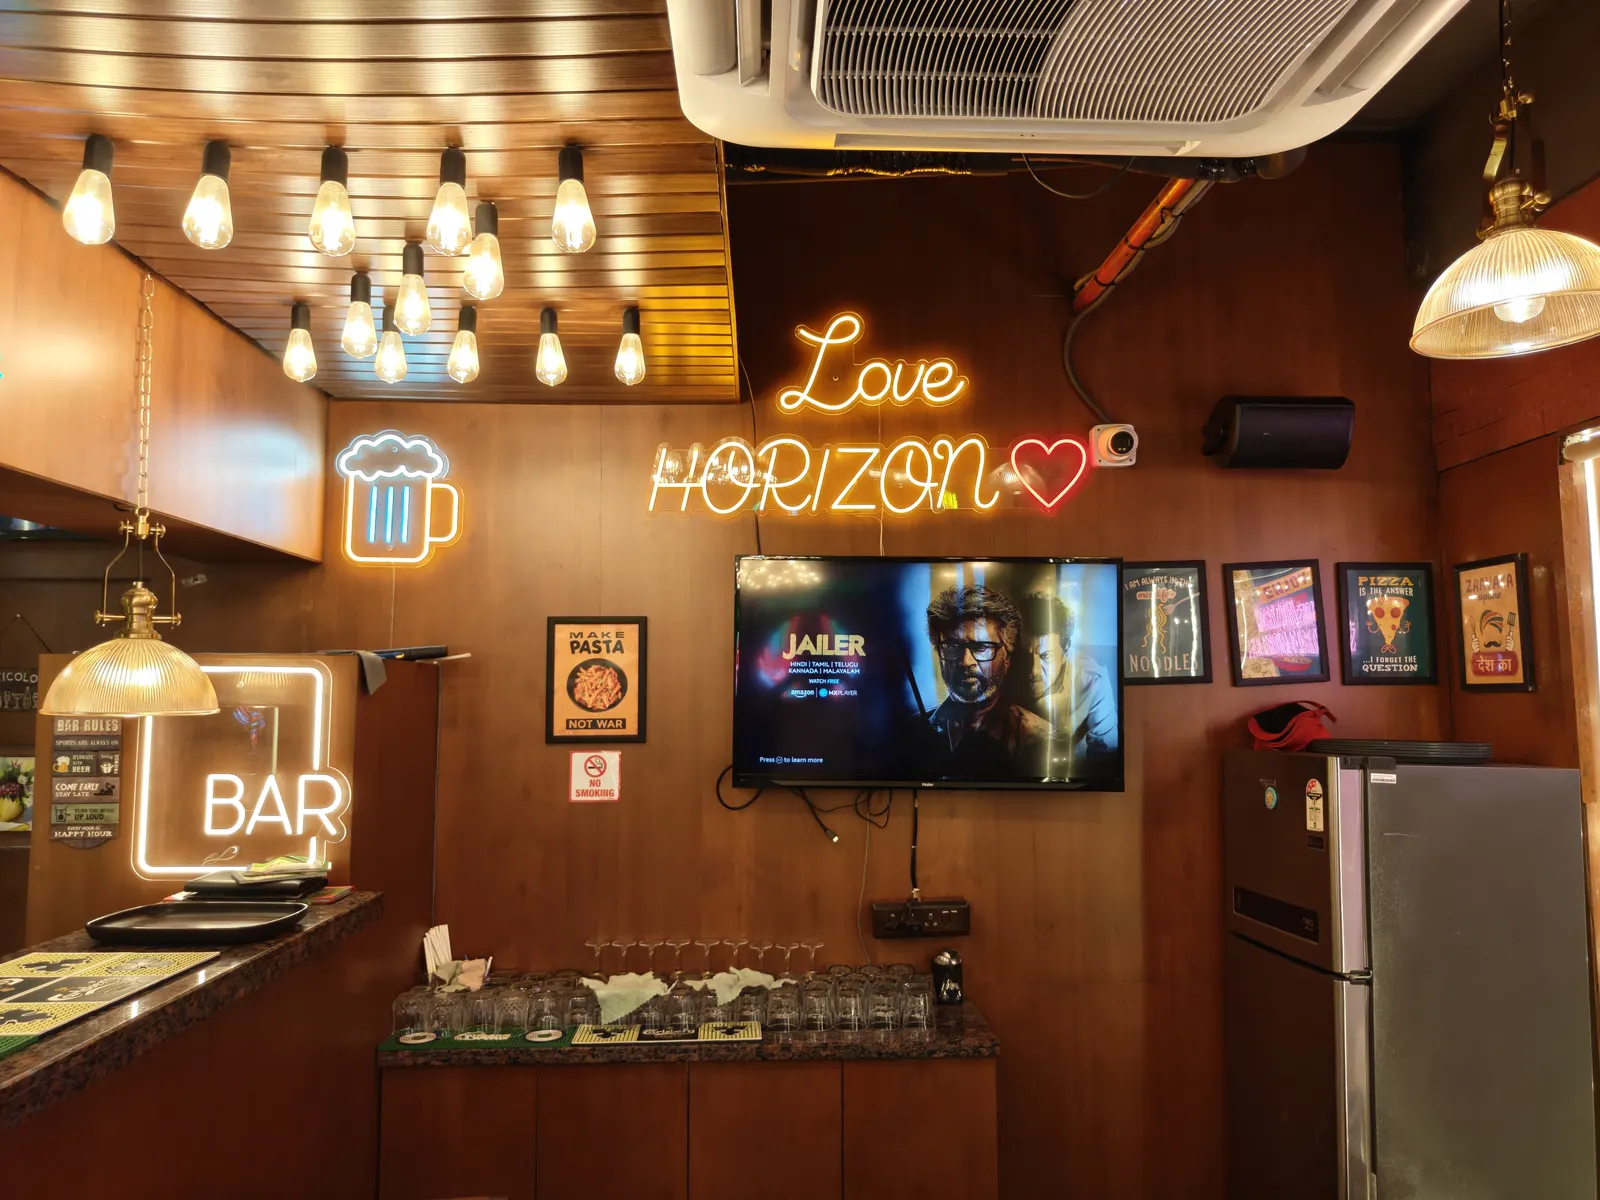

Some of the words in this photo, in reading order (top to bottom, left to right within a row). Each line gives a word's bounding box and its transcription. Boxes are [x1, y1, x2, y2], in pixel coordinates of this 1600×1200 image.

[780, 314, 965, 411] Love
[648, 437, 999, 514] HORIZON
[1129, 580, 1141, 589] AM
[1141, 575, 1168, 587] ALWAYS
[1358, 576, 1414, 586] PIZZA
[1359, 587, 1366, 596] IS
[1370, 587, 1382, 596] THE
[1385, 587, 1414, 597] ANSWER
[569, 631, 625, 639] MAKE
[569, 640, 625, 655] PASTA
[782, 633, 867, 660] JAILER
[1376, 656, 1402, 664] FORGET
[1404, 655, 1417, 663] THE
[1476, 655, 1495, 673] देश
[1362, 664, 1418, 673] QUESTION
[57, 718, 80, 732] BAR
[83, 718, 119, 732] RULES
[569, 719, 593, 729] NOT
[596, 719, 623, 729] WAR
[55, 783, 78, 791] COME
[79, 782, 100, 791] EARLY
[589, 779, 601, 788] NO
[575, 789, 615, 798] SMOKING
[203, 773, 343, 836] BAR
[74, 813, 84, 821] UP
[86, 813, 105, 821] LOUD
